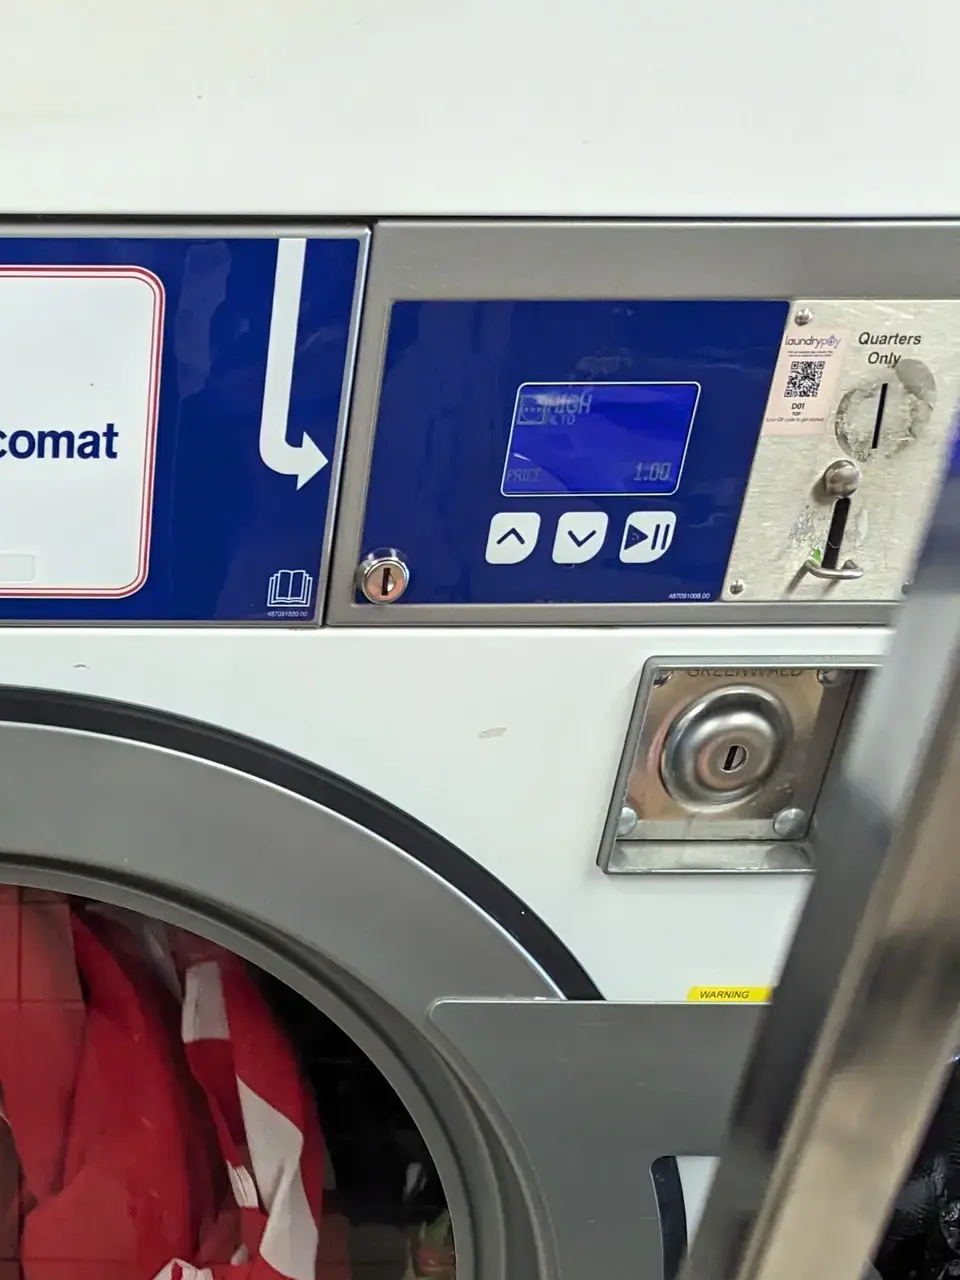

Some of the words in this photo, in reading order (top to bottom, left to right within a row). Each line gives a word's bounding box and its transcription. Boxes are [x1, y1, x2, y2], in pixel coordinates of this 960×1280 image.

[858, 331, 922, 346] Quarters
[867, 352, 902, 368] Only
[791, 402, 805, 410] D01
[633, 462, 673, 481] 1.00
[699, 990, 750, 999] WARNING
